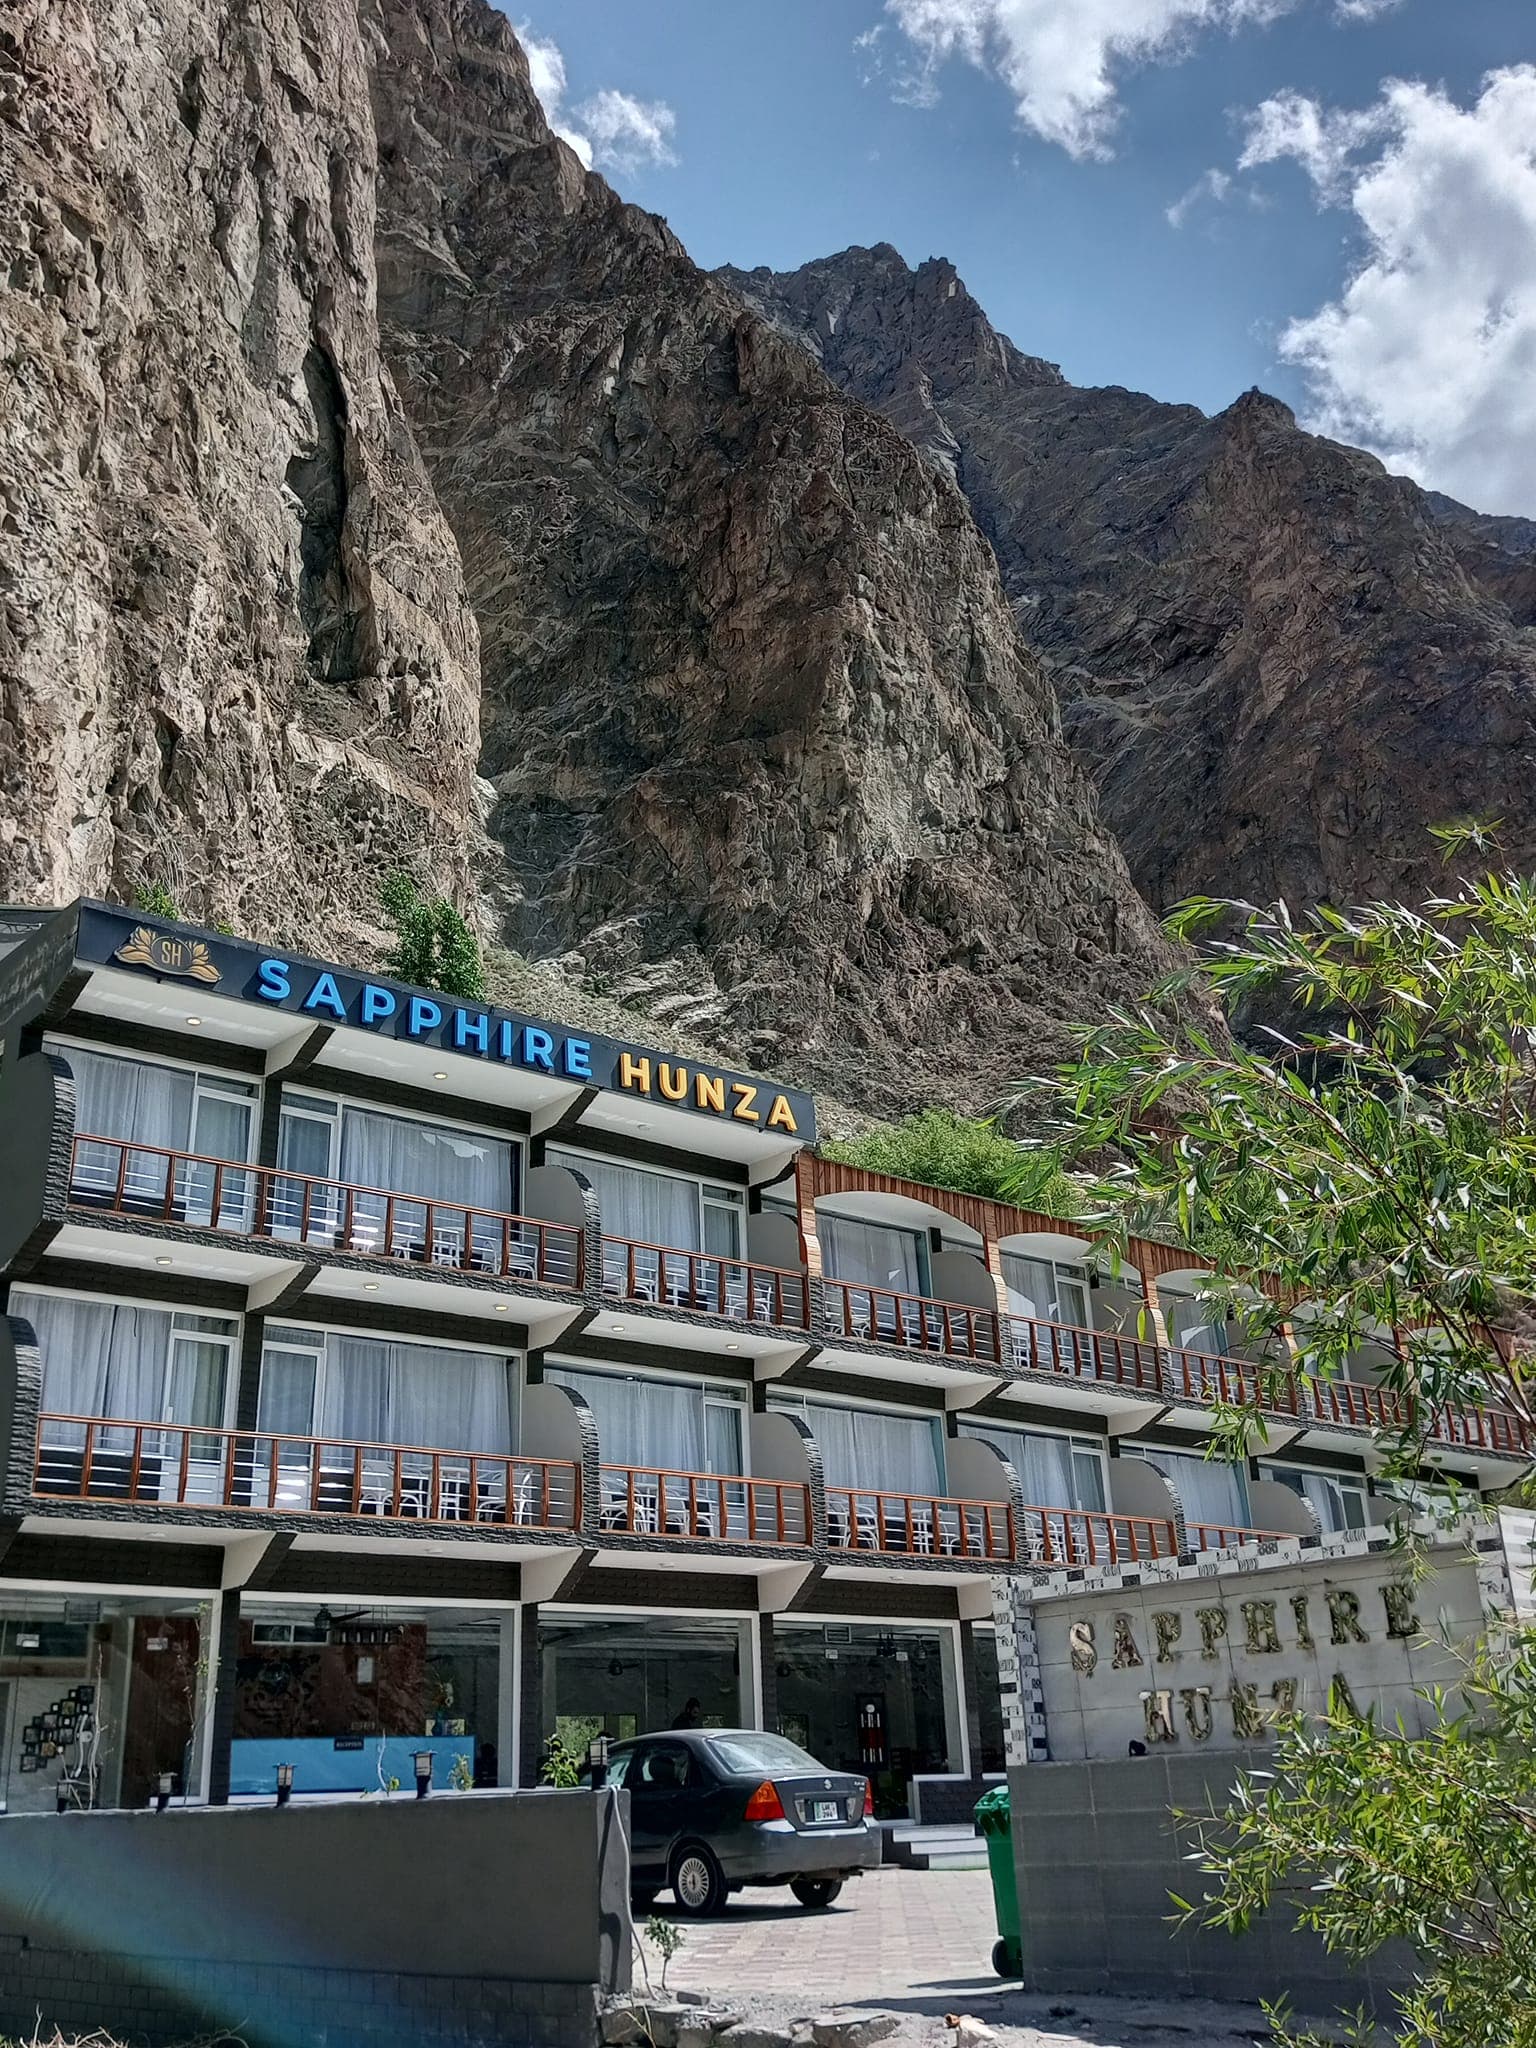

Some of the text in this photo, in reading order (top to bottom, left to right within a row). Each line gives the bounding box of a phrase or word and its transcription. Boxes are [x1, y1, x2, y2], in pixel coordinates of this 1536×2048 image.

[162, 941, 182, 967] SH
[258, 959, 798, 1132] SAPPHIRE HUNZA
[1069, 1584, 1420, 1673] SAPPHIRE
